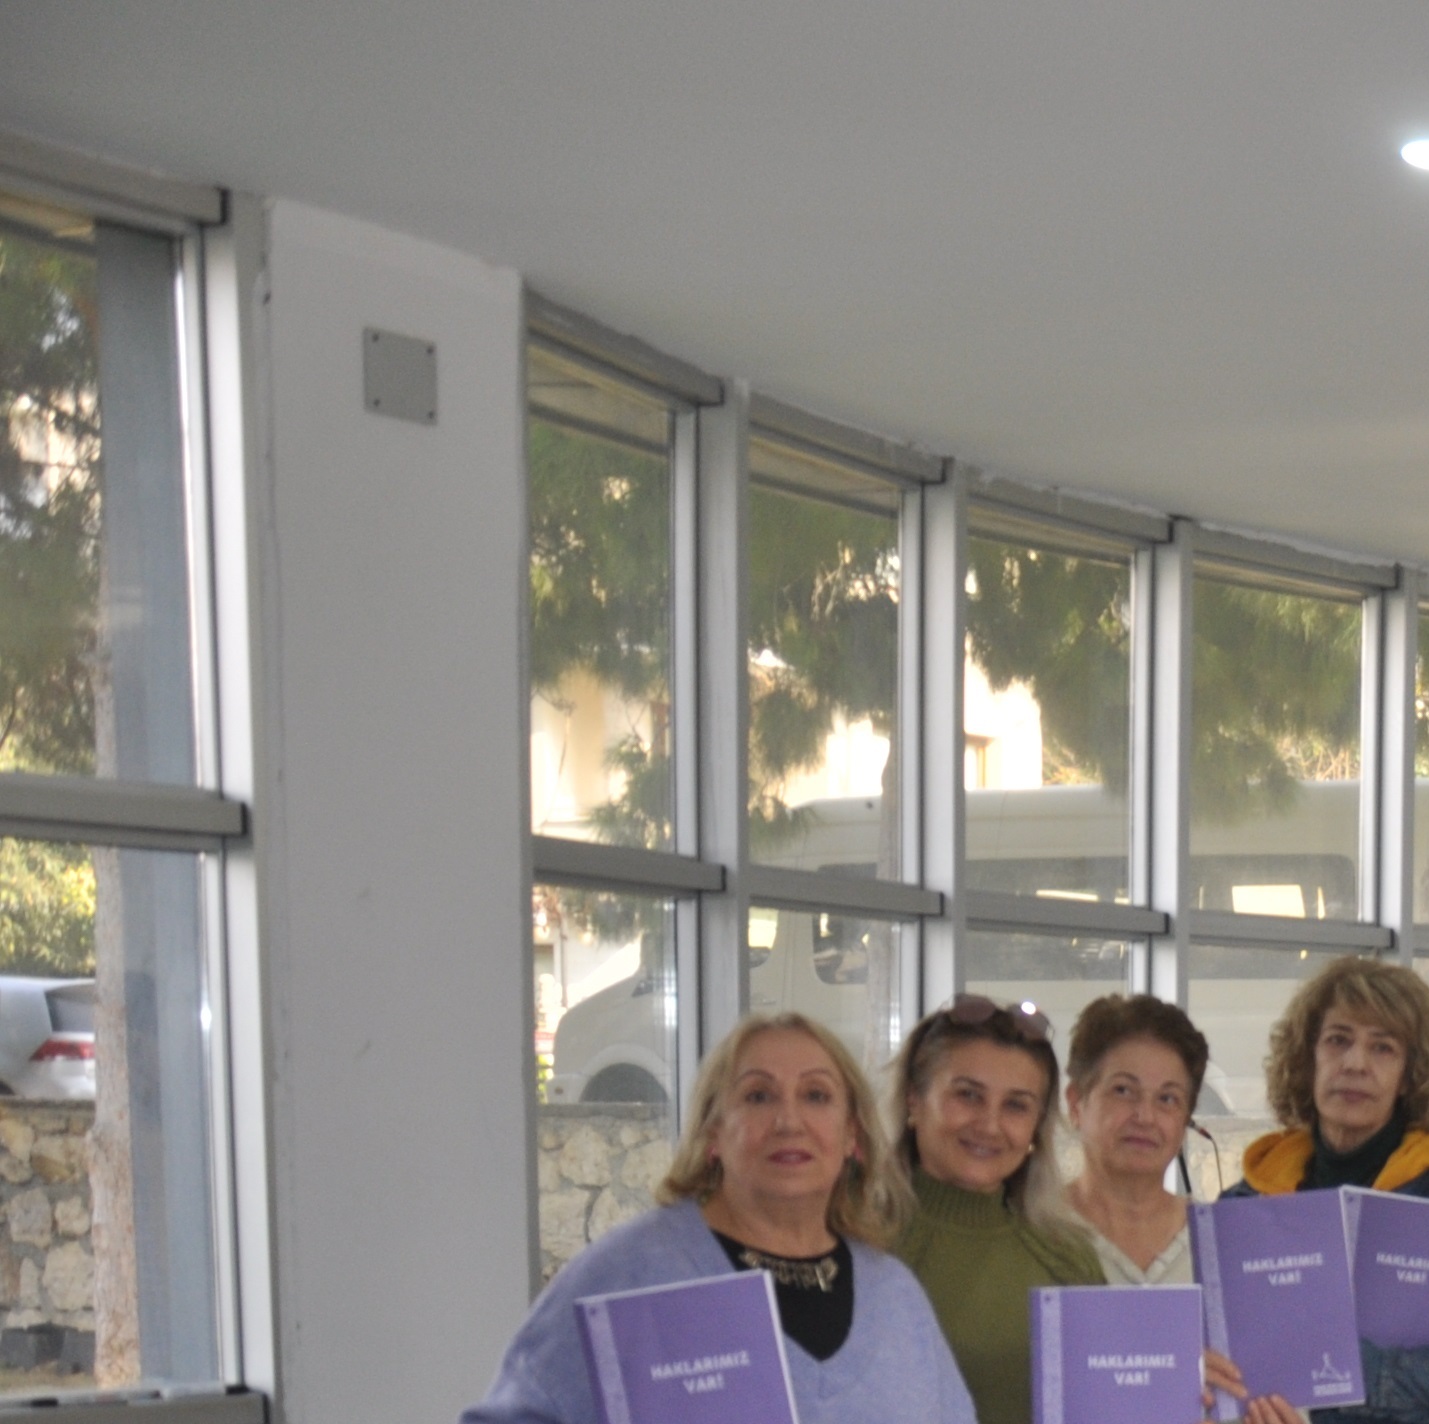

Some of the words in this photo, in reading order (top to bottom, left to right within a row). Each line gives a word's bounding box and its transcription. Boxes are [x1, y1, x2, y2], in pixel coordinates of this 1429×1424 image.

[1242, 1252, 1324, 1272] HAKLARIMIZ
[1268, 1270, 1302, 1286] VAR!
[650, 1350, 751, 1379] HAKLARIMIZ
[1087, 1354, 1176, 1369] HAKLARIMIZ
[684, 1372, 725, 1393] VAR!
[1114, 1370, 1150, 1385] VAR!
